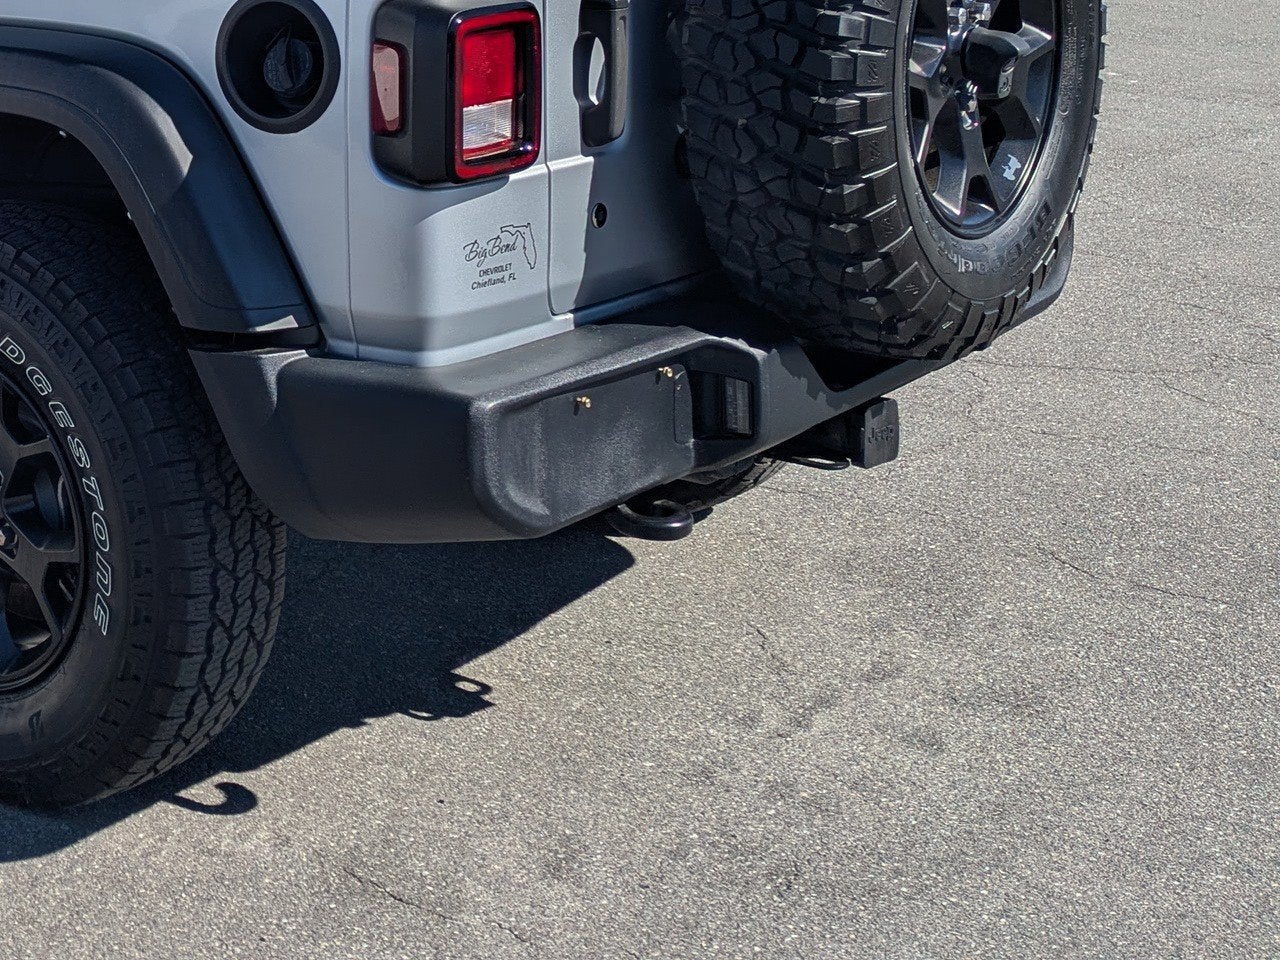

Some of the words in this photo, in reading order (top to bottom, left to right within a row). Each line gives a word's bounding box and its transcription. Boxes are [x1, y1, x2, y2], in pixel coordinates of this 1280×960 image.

[463, 239, 487, 267] Big
[486, 234, 519, 257] Bend
[479, 263, 512, 277] CHEVROLET
[471, 276, 507, 291] Chiefland,
[508, 272, 517, 282] FL
